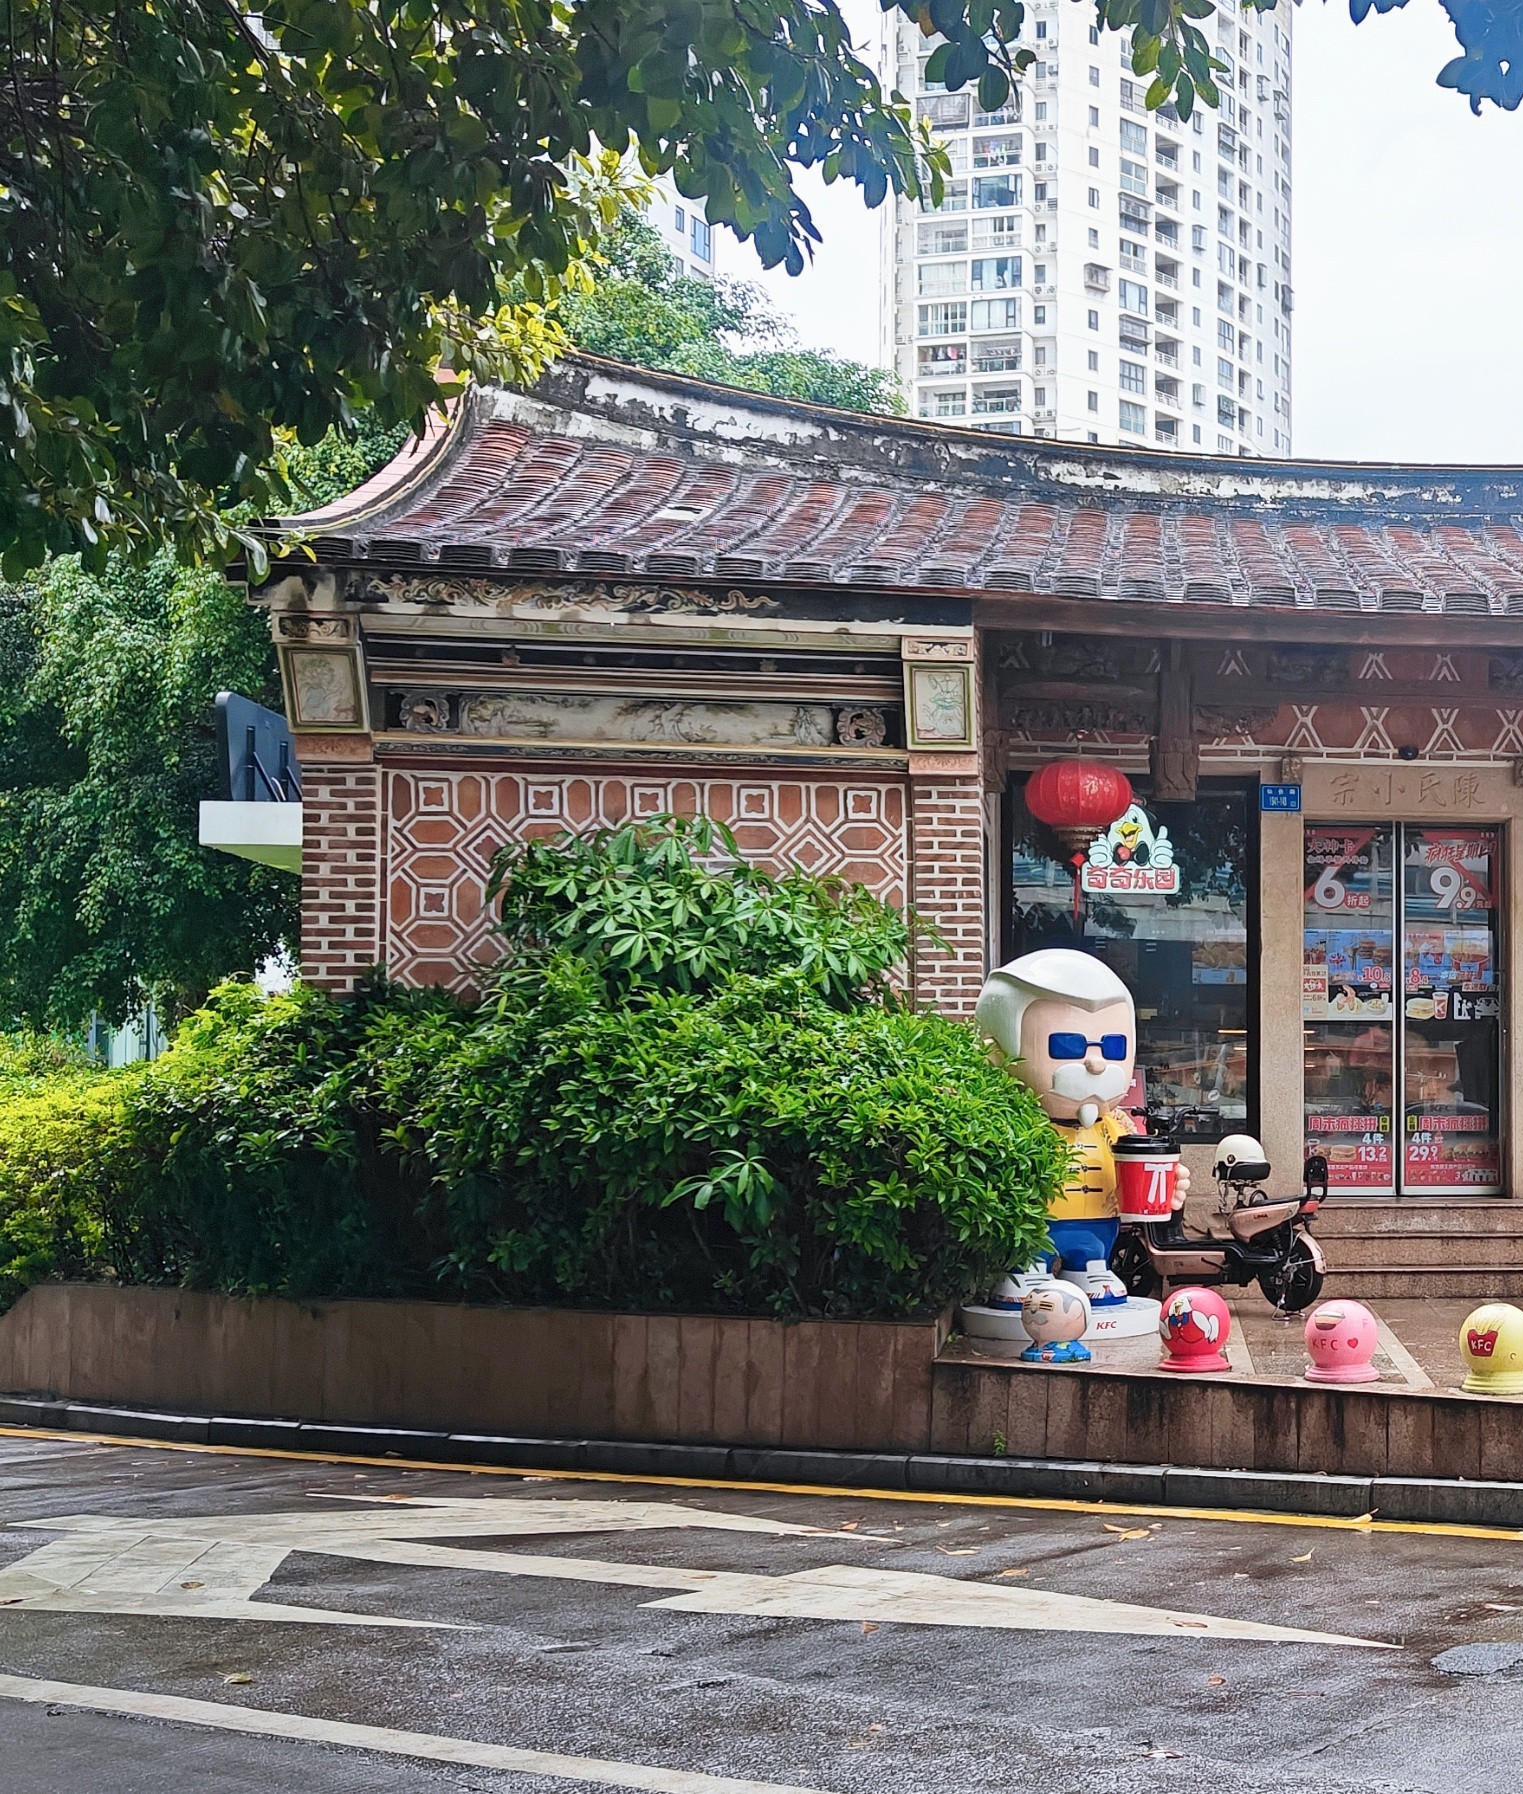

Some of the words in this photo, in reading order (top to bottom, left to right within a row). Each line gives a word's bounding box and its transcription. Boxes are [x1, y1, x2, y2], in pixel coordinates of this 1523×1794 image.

[1087, 865, 1176, 890] 奇奇乐园
[1362, 1132, 1384, 1145] 4件
[1411, 1132, 1432, 1144] 4件
[1096, 1321, 1117, 1330] KFC
[1311, 1338, 1339, 1351] KFC
[1470, 1339, 1492, 1352] KFC
